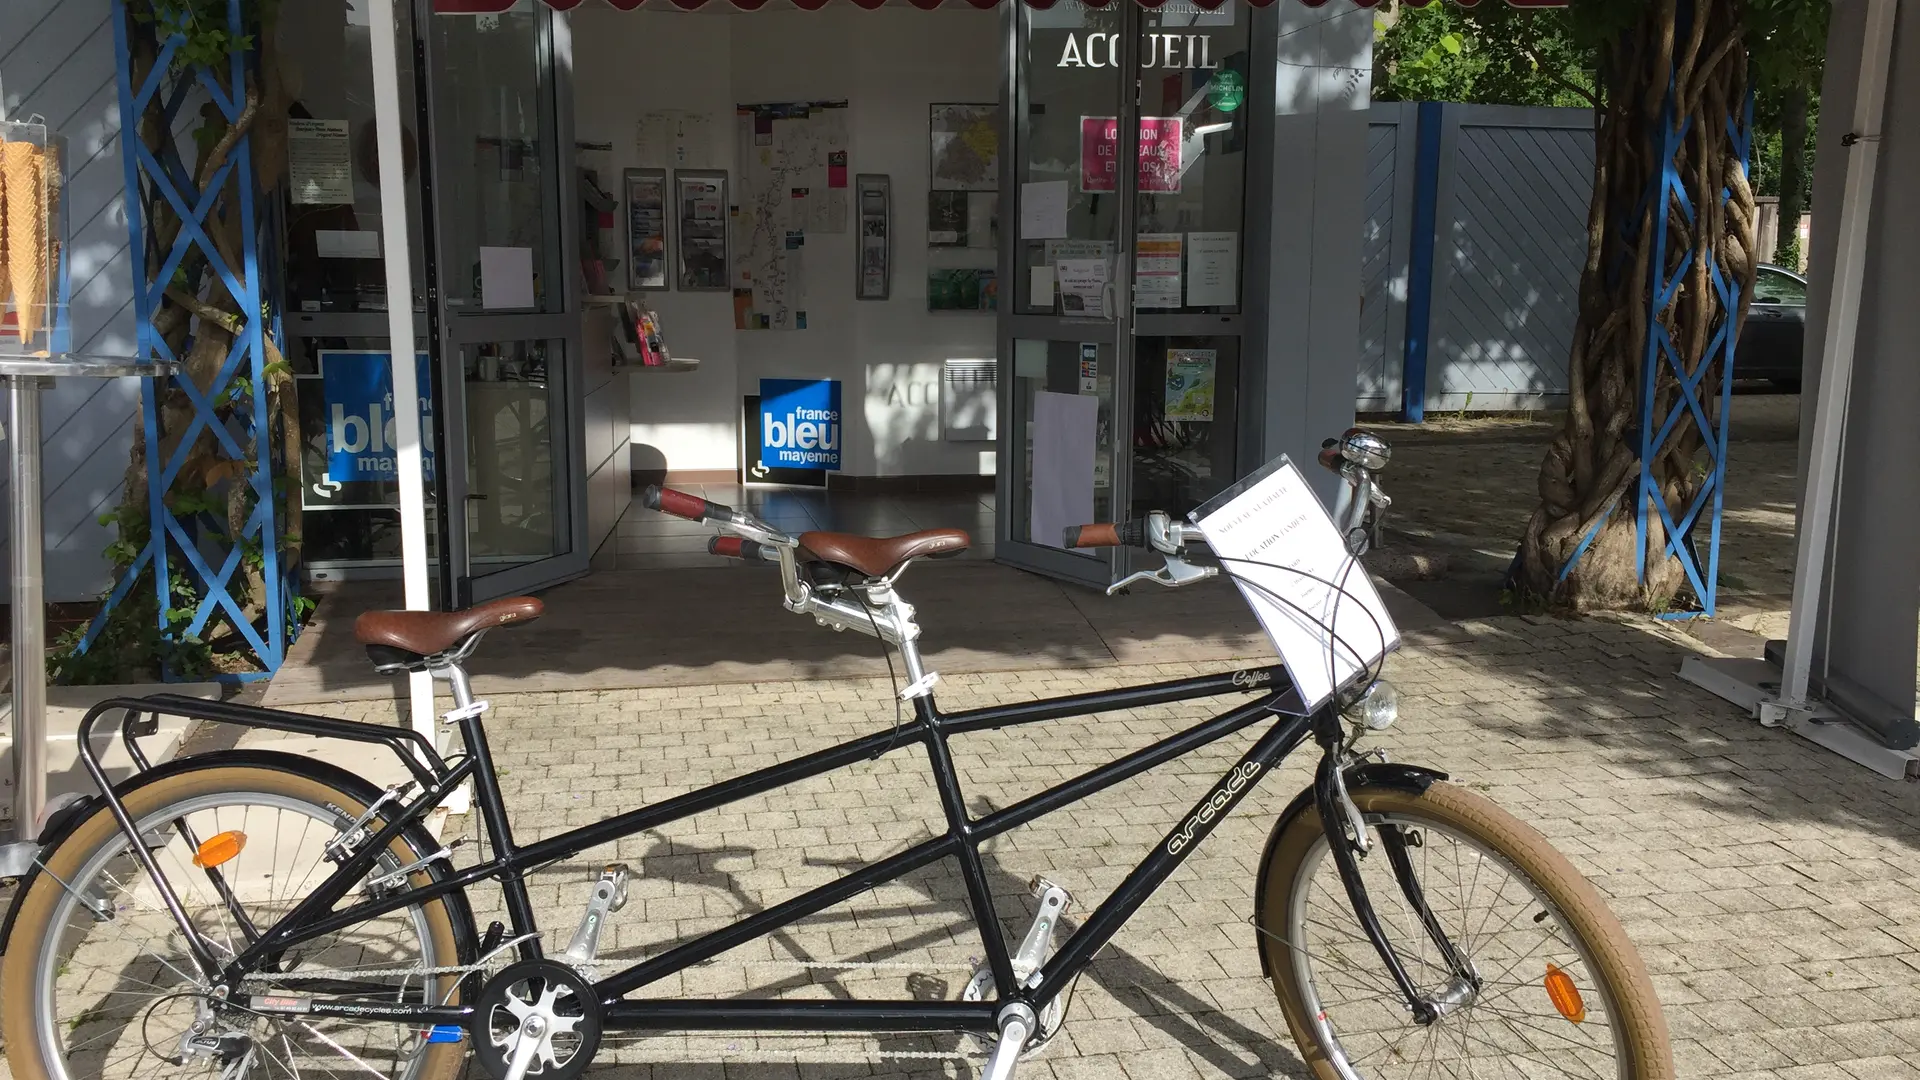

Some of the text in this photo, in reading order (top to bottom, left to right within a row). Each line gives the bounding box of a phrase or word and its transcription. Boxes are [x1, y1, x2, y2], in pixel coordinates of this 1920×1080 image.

[1210, 84, 1244, 92] MICHELIN
[1098, 144, 1111, 156] DE
[796, 406, 838, 421] france
[764, 412, 838, 450] bleu
[779, 449, 838, 465] mayenne
[1244, 533, 1280, 561] LOCATION
[1231, 669, 1271, 688] Coffee
[1167, 760, 1261, 856] arcade
[264, 997, 280, 1006] City
[311, 1003, 412, 1015] www.arcadecycles.com
